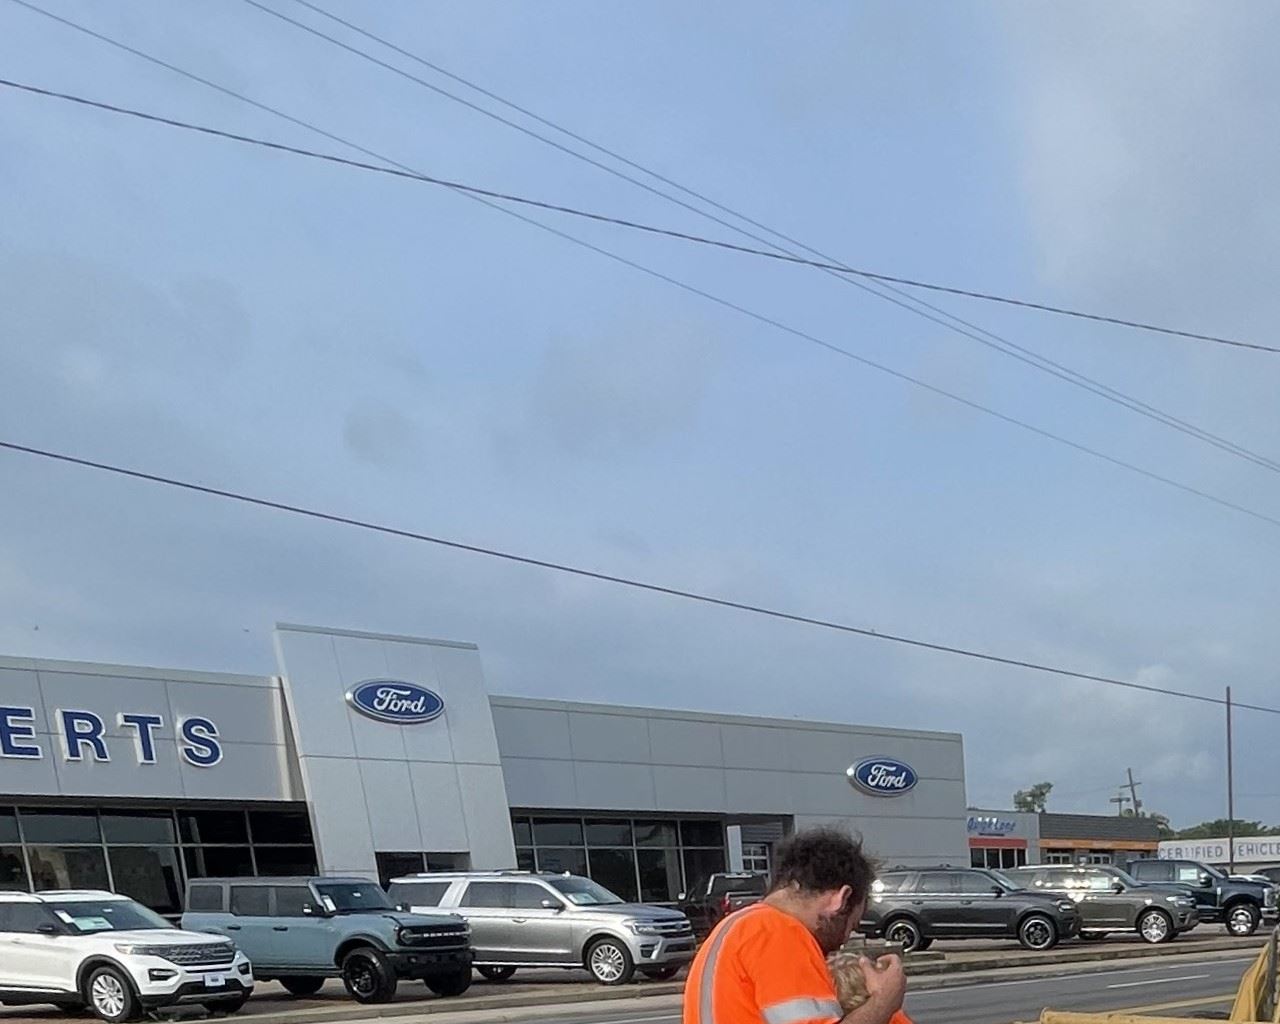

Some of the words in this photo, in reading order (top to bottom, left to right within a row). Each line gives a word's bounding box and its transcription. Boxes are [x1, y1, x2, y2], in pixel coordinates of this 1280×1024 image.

[373, 687, 426, 713] Ford
[0, 705, 223, 767] ERTS
[867, 764, 906, 788] Ford
